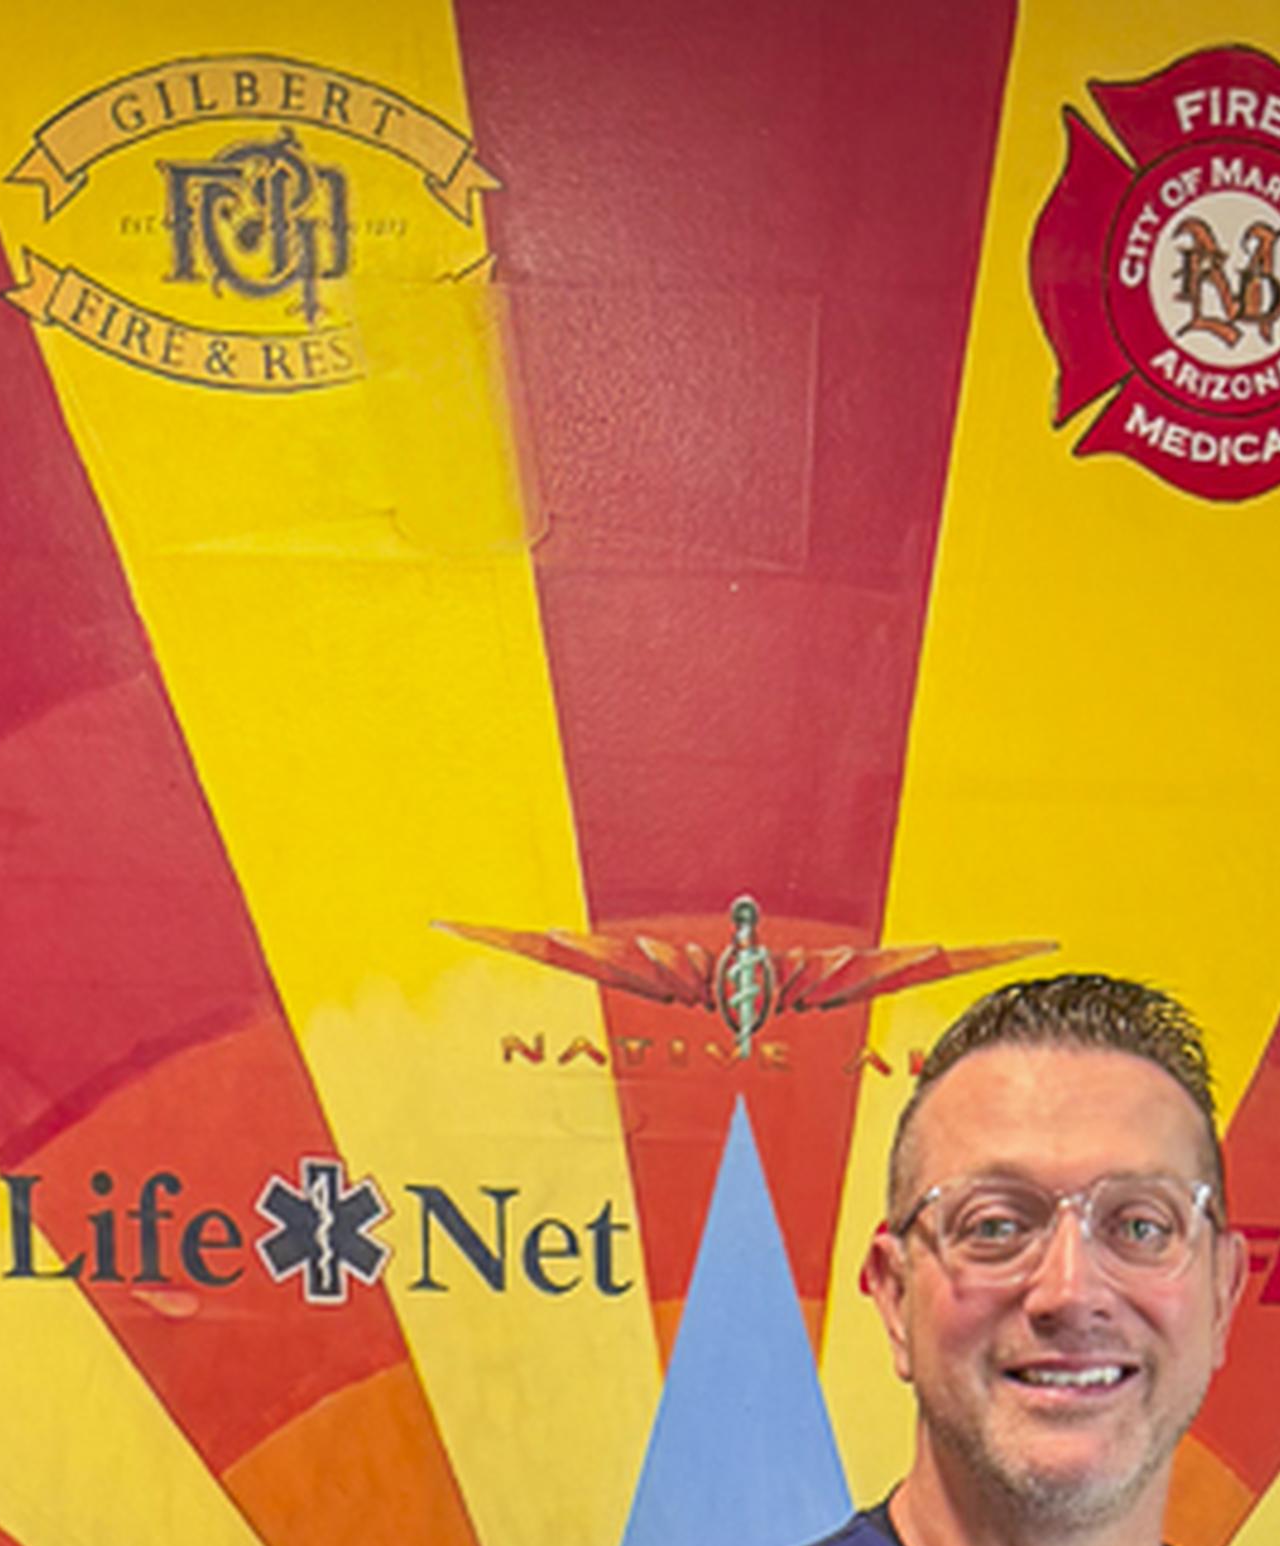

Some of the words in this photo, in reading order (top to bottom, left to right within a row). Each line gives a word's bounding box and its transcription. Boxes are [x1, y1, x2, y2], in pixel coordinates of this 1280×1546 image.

[111, 72, 406, 138] GILBERT
[1120, 204, 1163, 288] CITY
[1160, 168, 1203, 207] OF
[69, 286, 187, 368] FIRE
[204, 340, 238, 379] &
[502, 1033, 792, 1073] NATIVE
[0, 1170, 247, 1287] Life
[403, 1182, 636, 1298] Net
